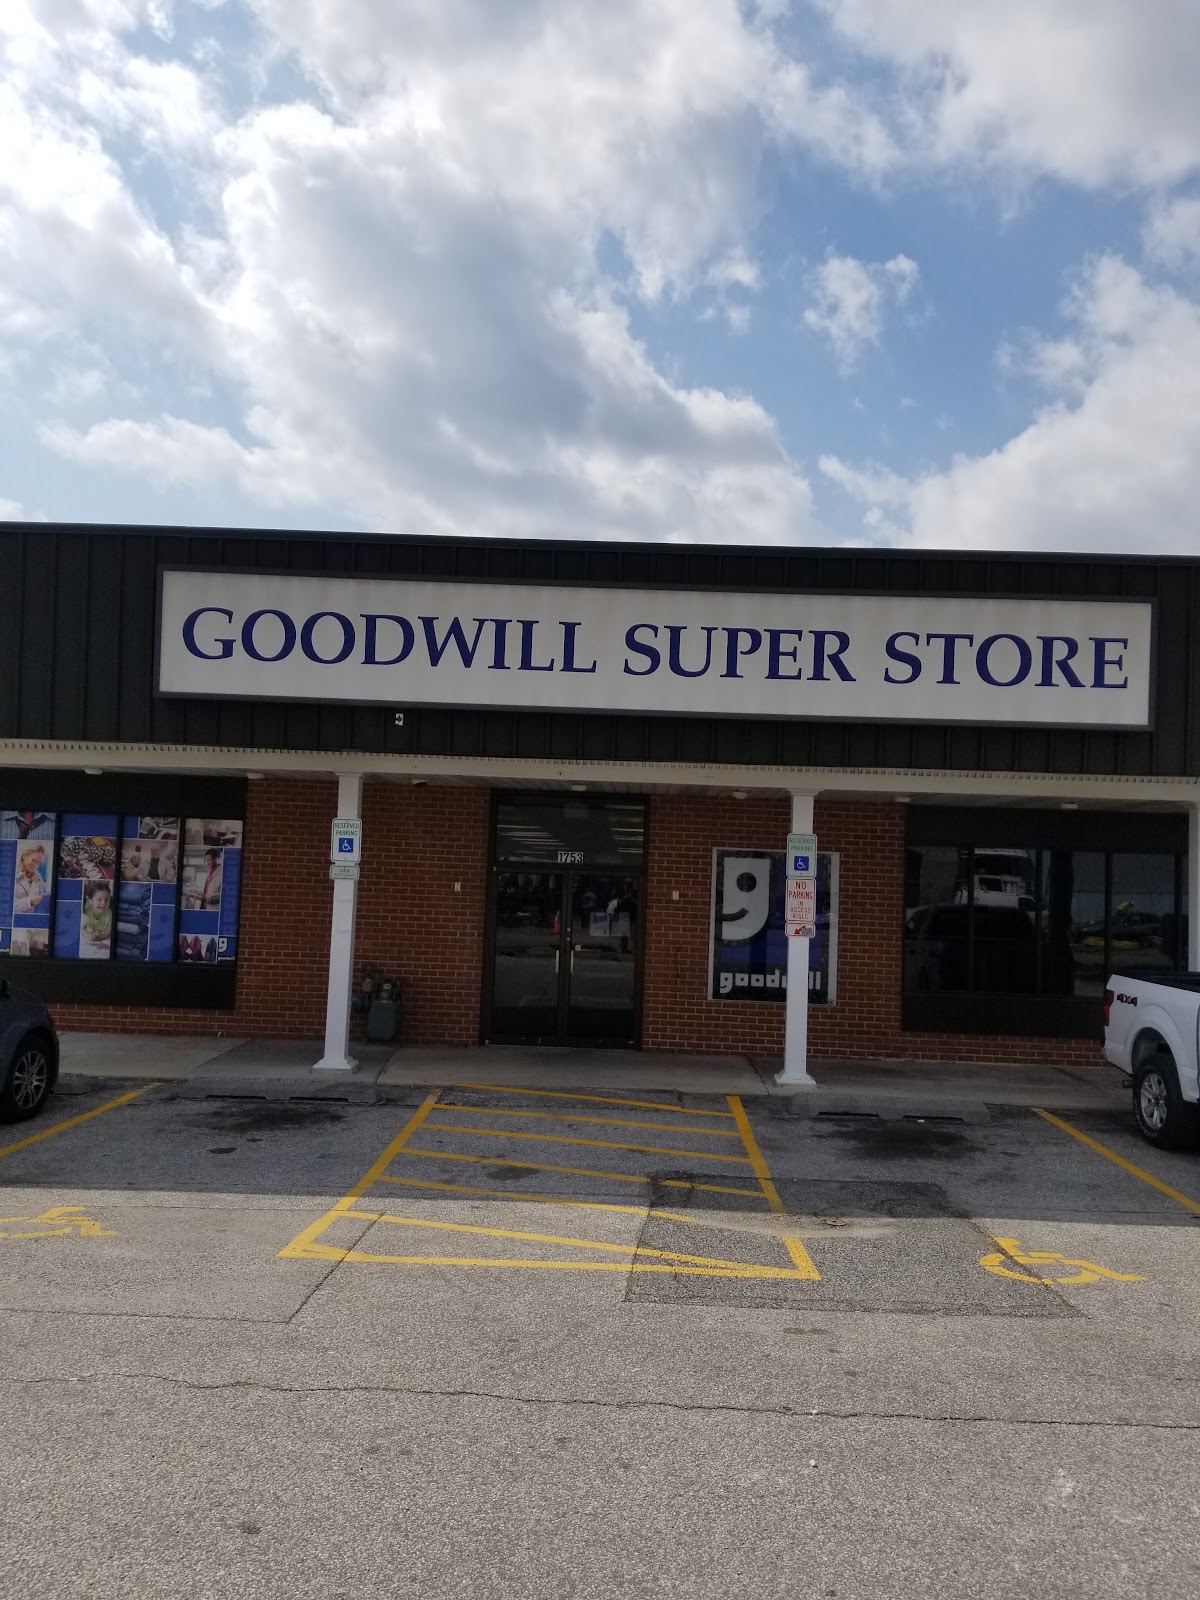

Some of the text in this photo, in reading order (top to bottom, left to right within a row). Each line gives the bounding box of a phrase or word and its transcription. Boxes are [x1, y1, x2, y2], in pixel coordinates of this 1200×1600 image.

[182, 606, 1130, 689] GOODWILL SUPER STORE
[558, 852, 583, 863] 1753
[795, 881, 807, 890] NO
[788, 890, 814, 900] PARKING
[790, 906, 811, 914] ACCESS
[719, 969, 821, 994] goodll
